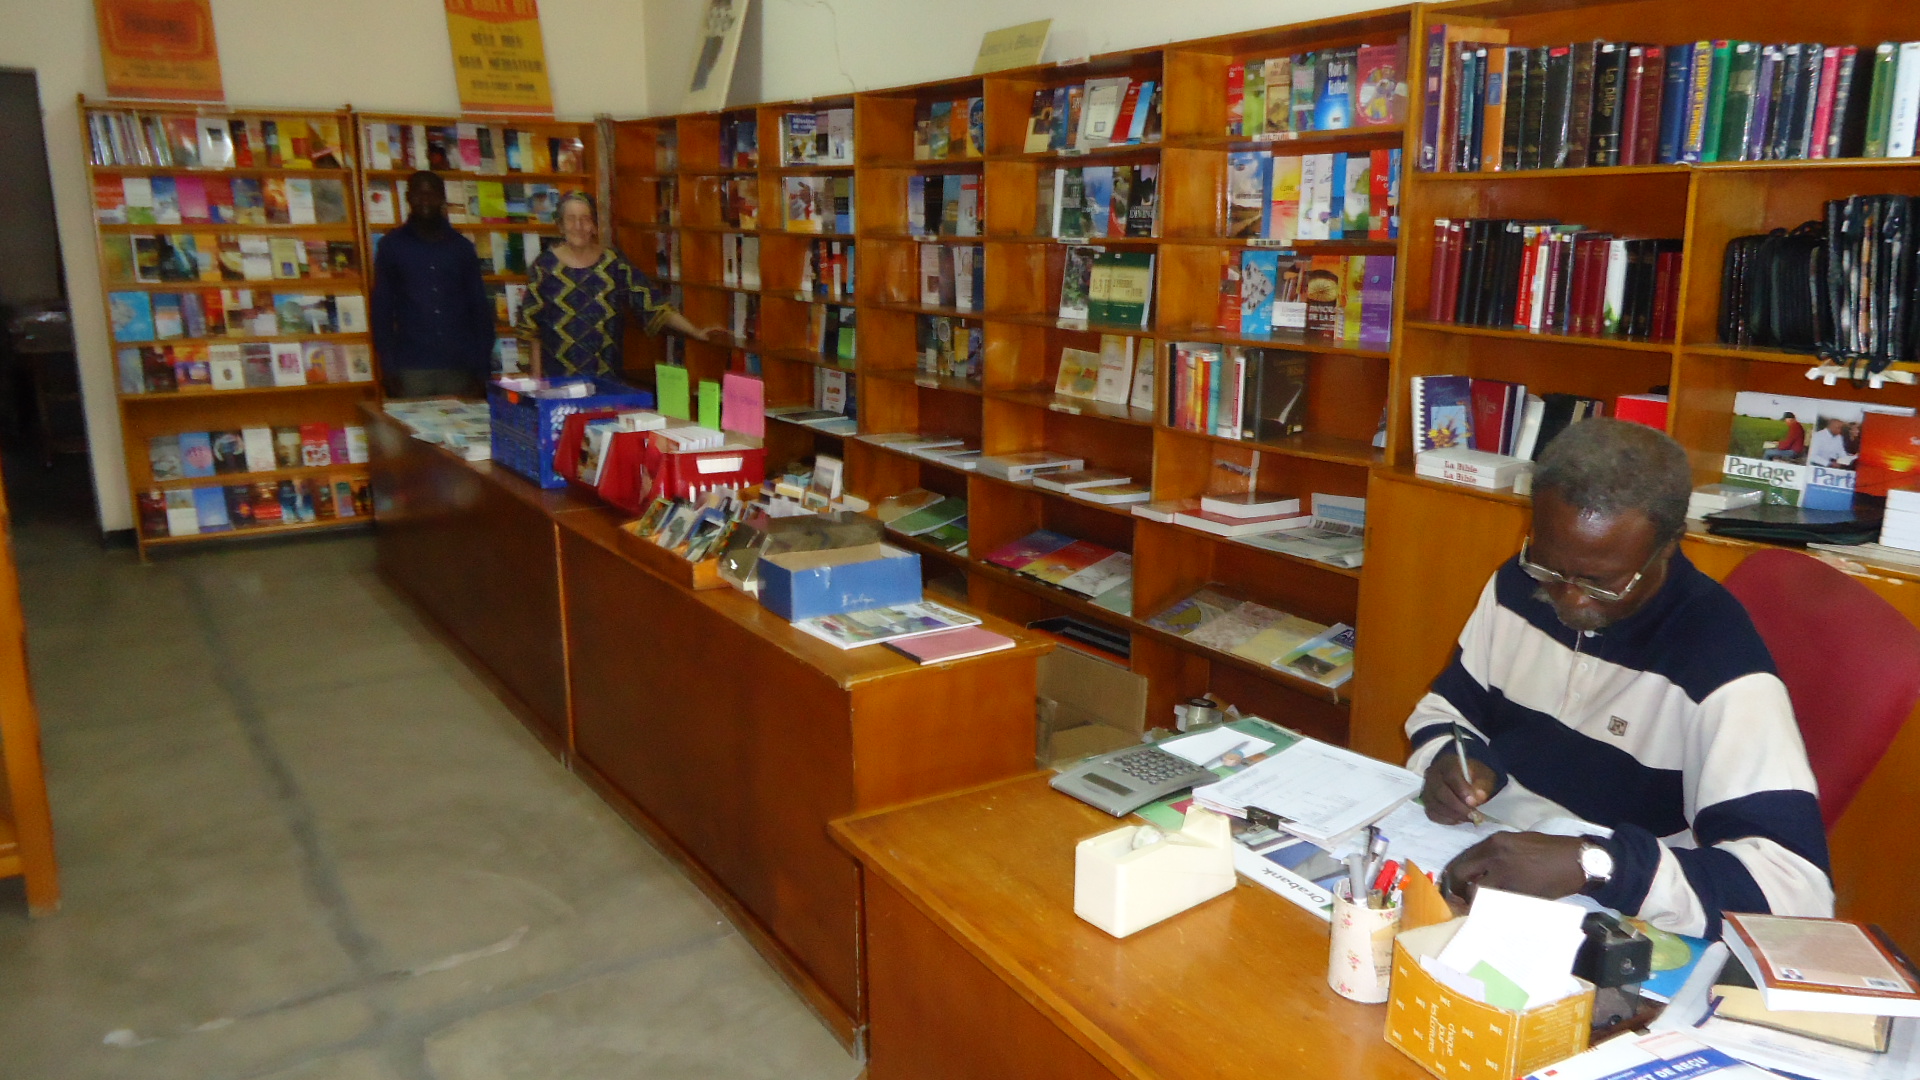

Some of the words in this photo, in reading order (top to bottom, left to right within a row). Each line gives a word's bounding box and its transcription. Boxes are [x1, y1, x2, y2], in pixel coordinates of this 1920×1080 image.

[1443, 470, 1454, 479] La
[1456, 472, 1477, 484] Bible
[1444, 460, 1455, 470] La
[1456, 462, 1478, 474] Bible
[1727, 457, 1795, 486] Partage
[1262, 867, 1325, 903] Orabank
[1654, 1068, 1677, 1079] DE
[1672, 1056, 1709, 1073] REÇU
